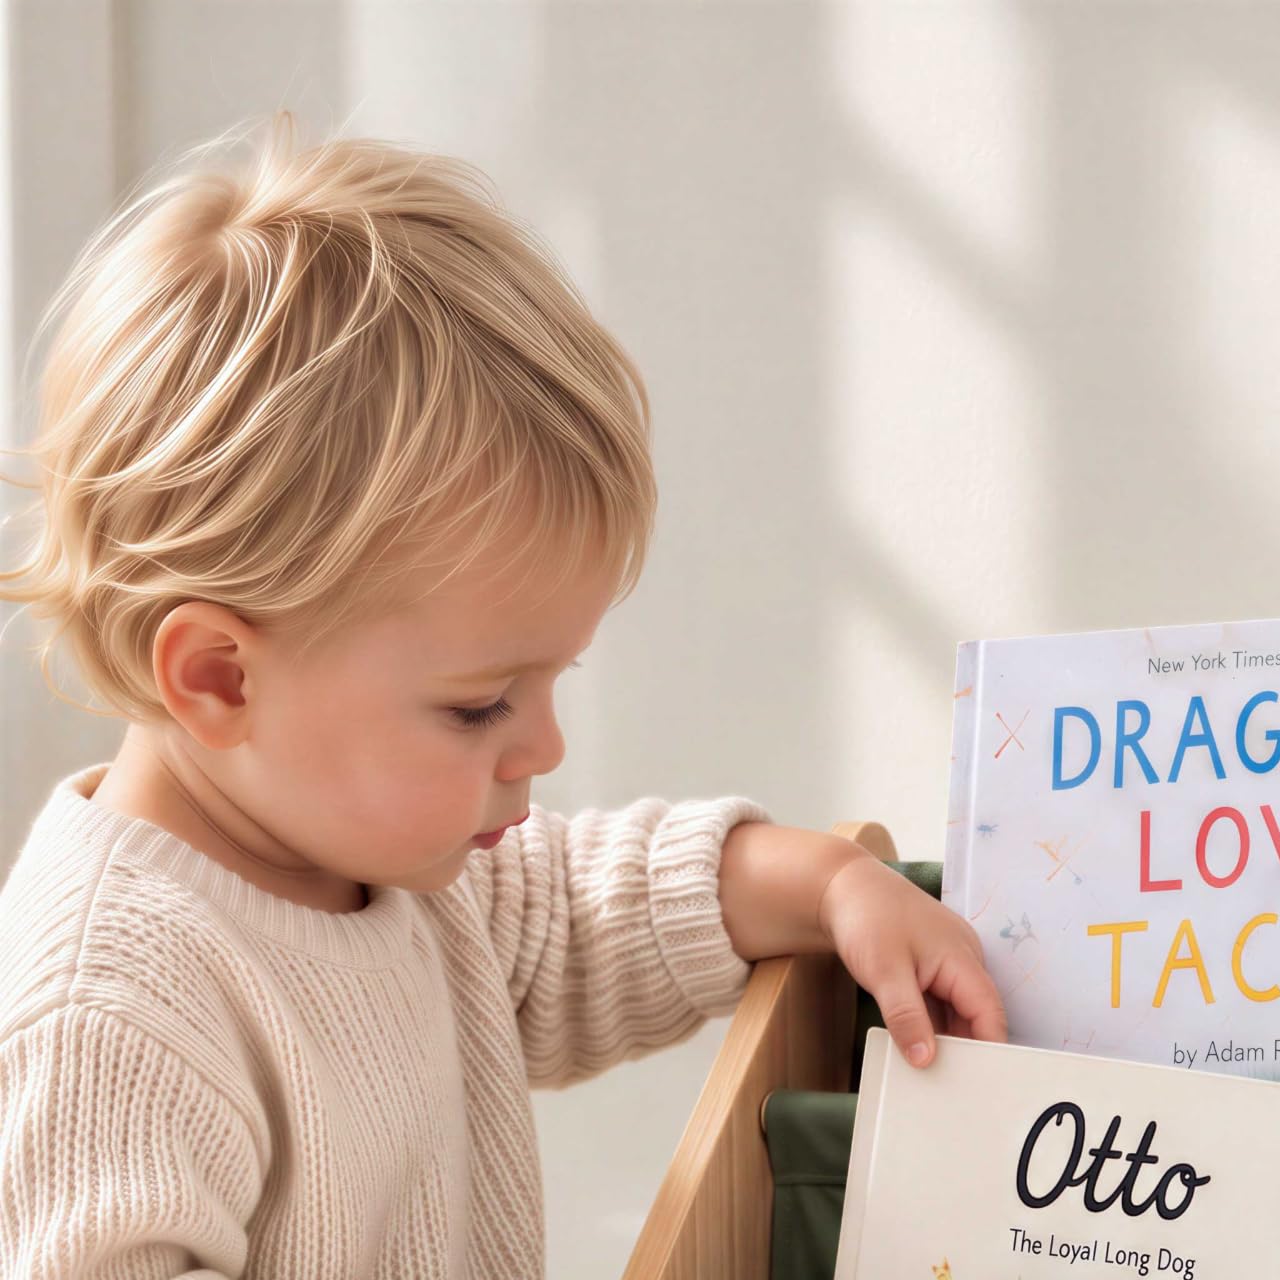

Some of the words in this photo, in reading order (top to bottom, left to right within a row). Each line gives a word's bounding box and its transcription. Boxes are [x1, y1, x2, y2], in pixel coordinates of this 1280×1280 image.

[1148, 658, 1185, 674] New
[1191, 652, 1226, 671] York
[1173, 1042, 1197, 1069] by
[1205, 1040, 1264, 1062] Adam
[1016, 1101, 1211, 1220] Otto
[1009, 1228, 1042, 1254] The
[1049, 1234, 1098, 1264] Loyal
[1104, 1241, 1151, 1276] Long
